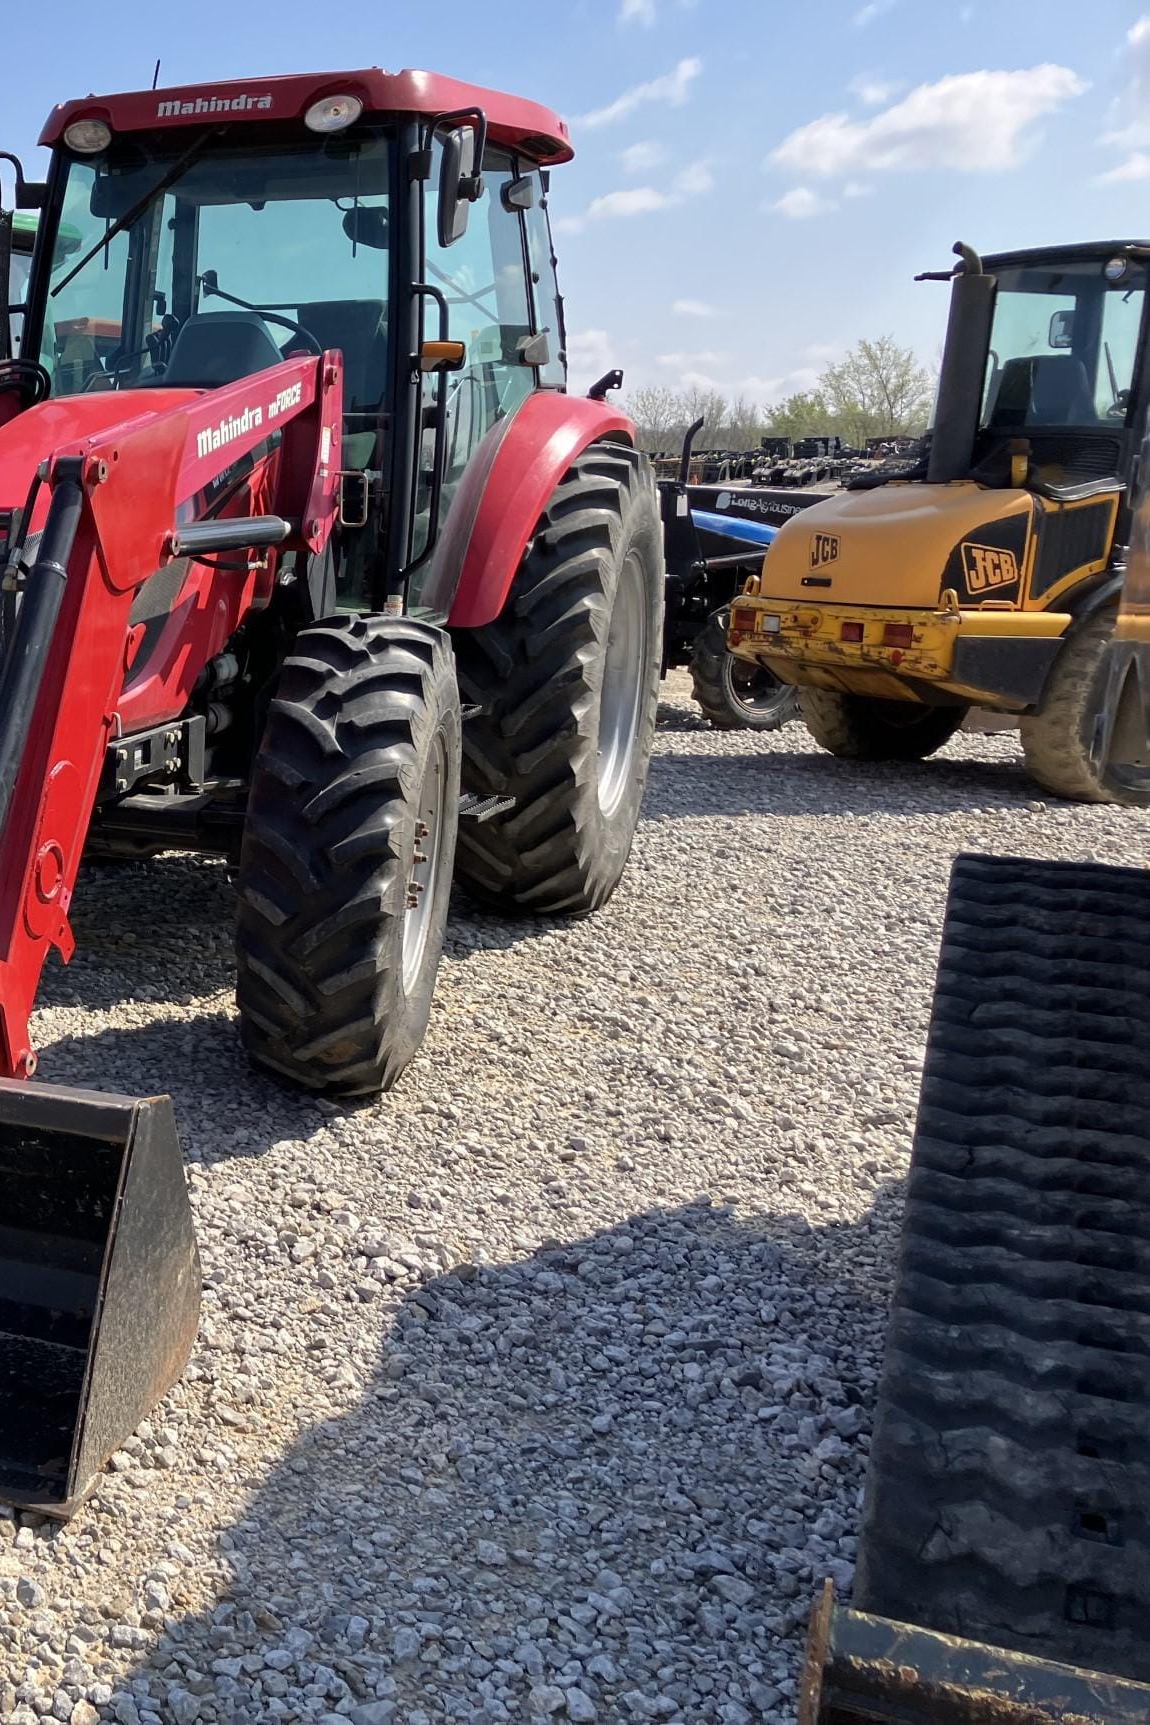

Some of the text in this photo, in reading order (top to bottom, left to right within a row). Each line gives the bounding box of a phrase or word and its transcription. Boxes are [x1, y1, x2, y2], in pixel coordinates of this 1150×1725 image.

[157, 94, 272, 117] Mahindra
[197, 381, 302, 458] Mahindra mFORCE
[811, 534, 839, 567] JCB
[969, 548, 1016, 589] JCB
